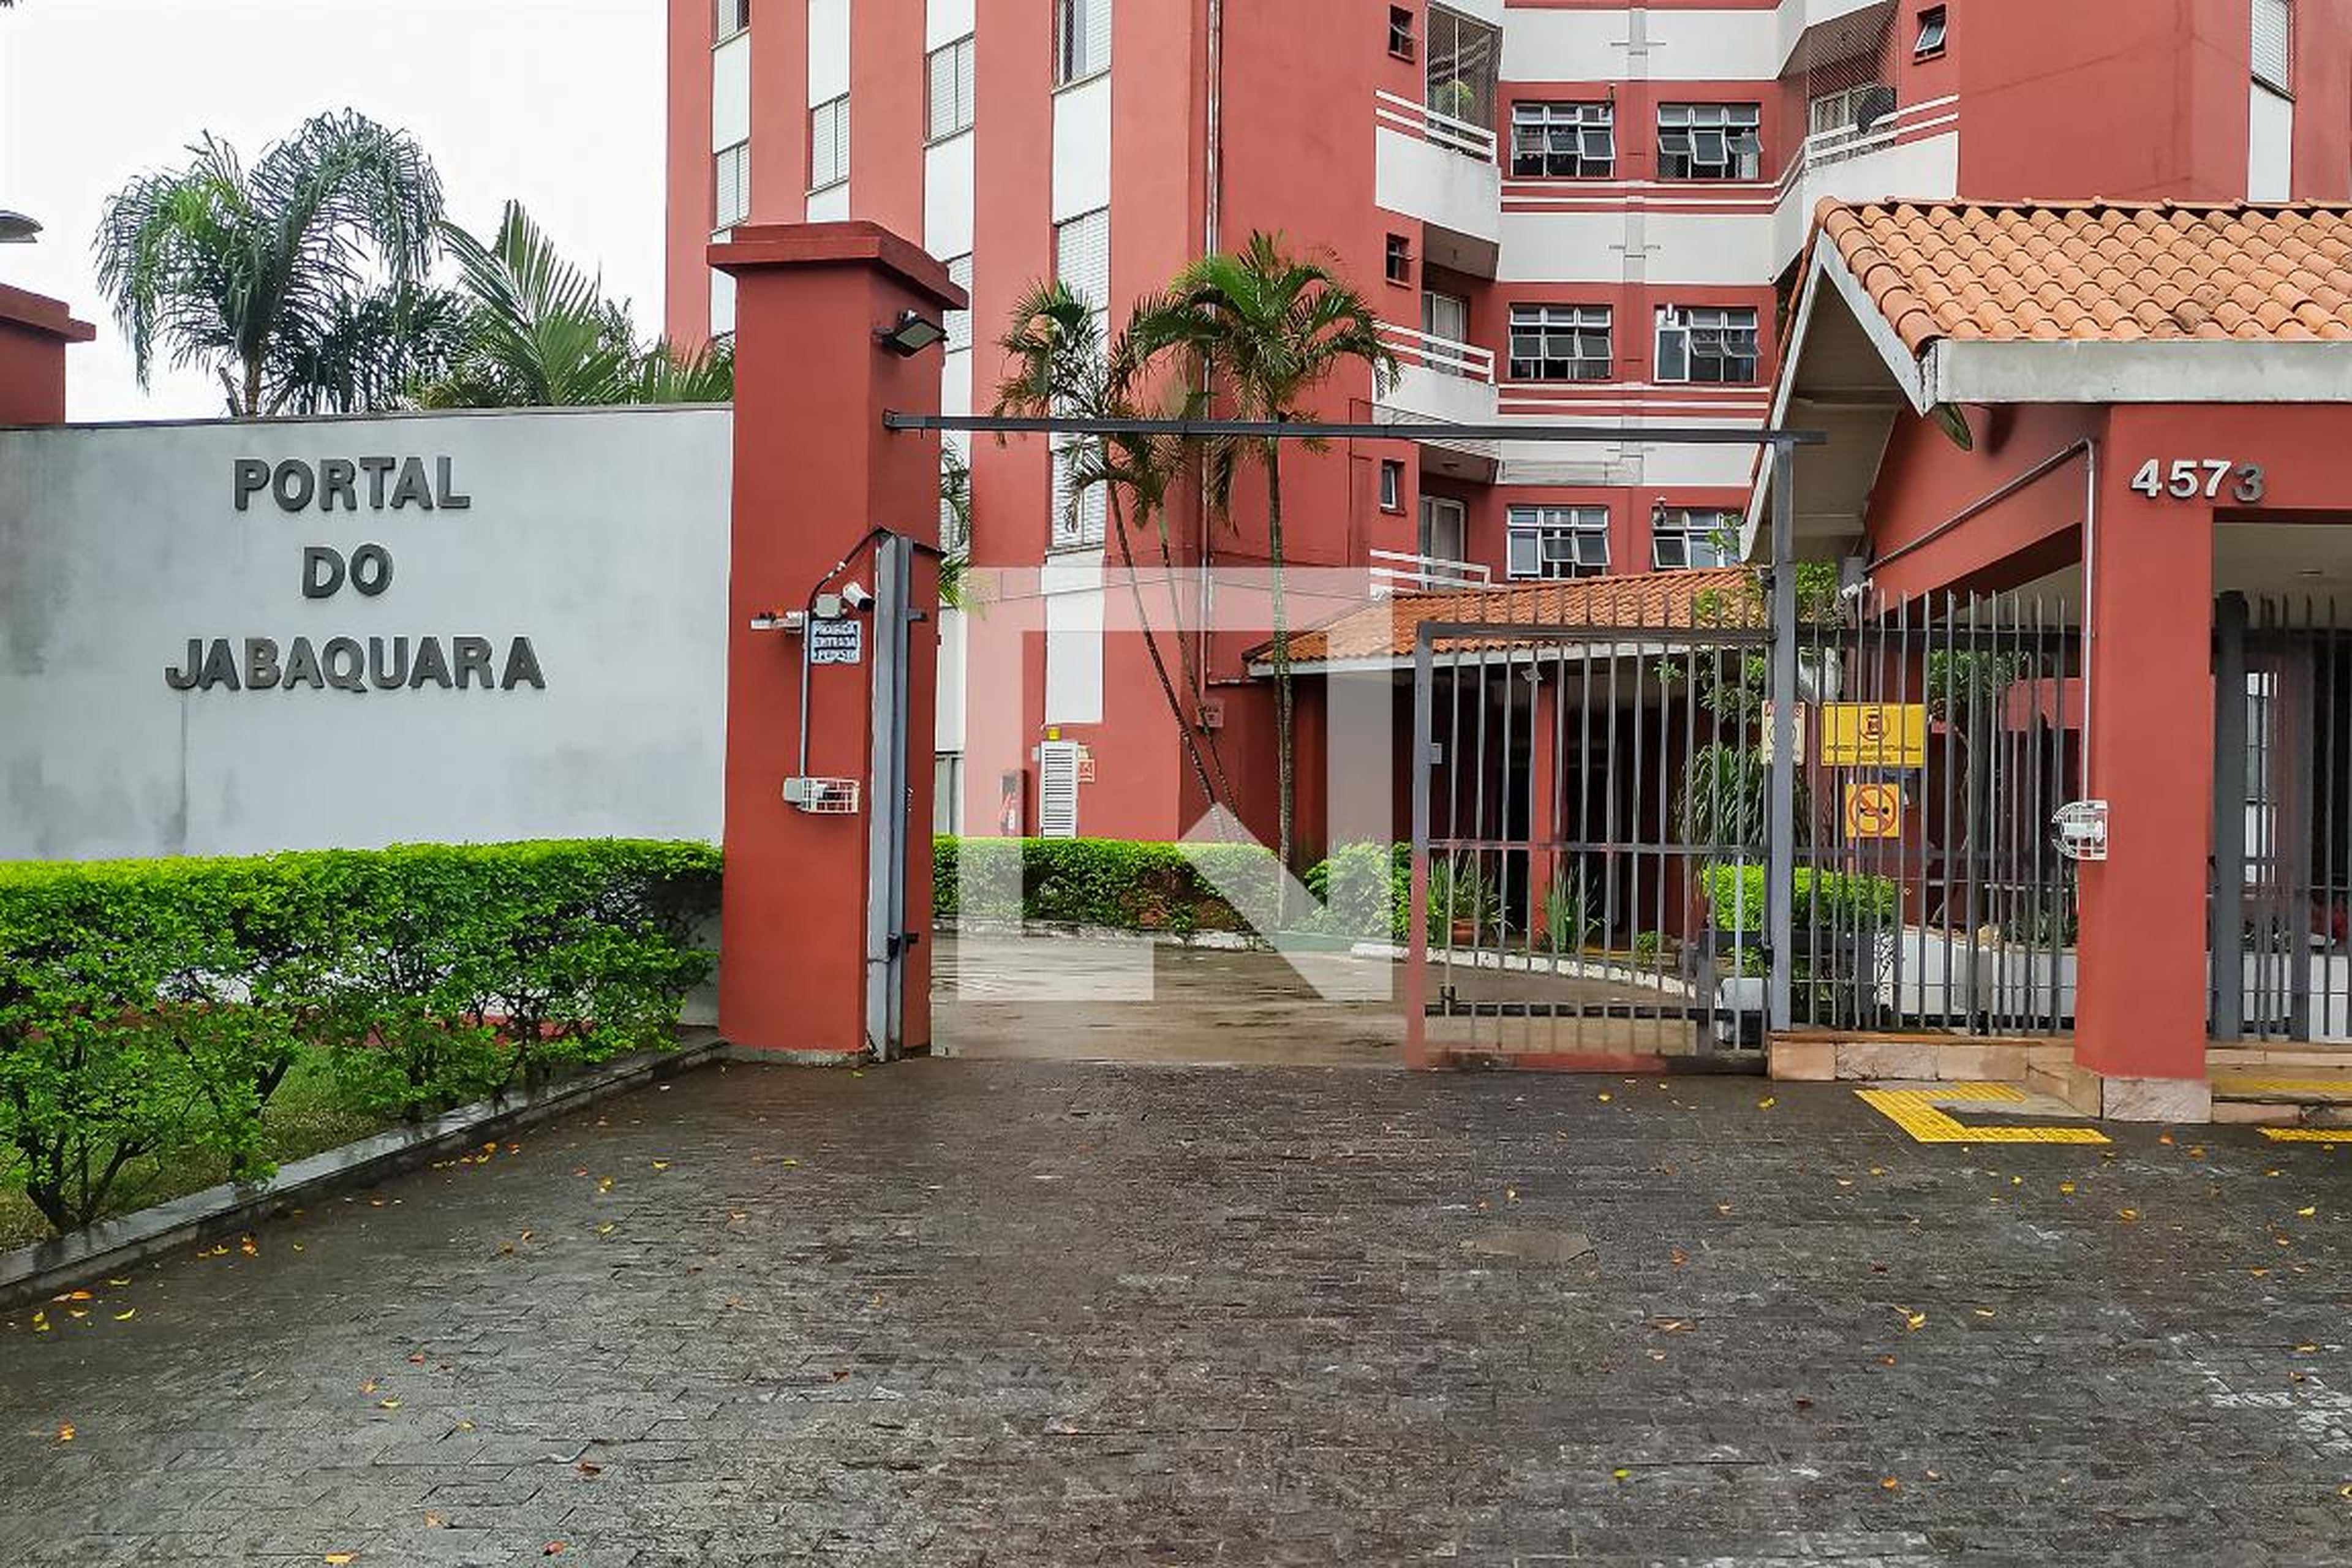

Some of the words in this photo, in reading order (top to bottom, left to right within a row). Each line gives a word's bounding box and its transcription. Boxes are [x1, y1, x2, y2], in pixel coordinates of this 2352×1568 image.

[233, 456, 470, 511] PORTAL
[2131, 459, 2265, 502] 4573
[302, 544, 393, 598] DO
[165, 636, 546, 692] JABAQUARA
